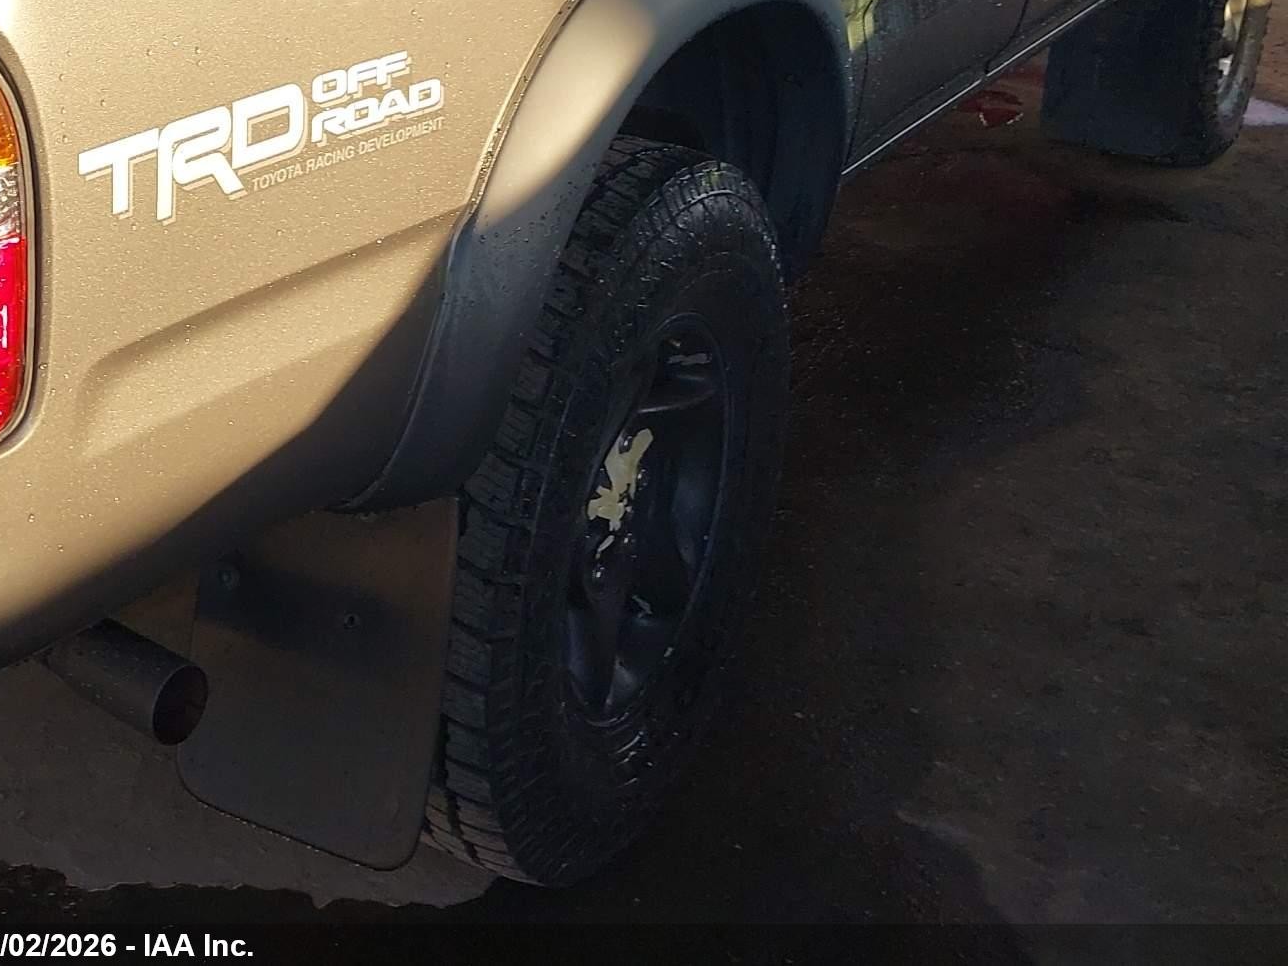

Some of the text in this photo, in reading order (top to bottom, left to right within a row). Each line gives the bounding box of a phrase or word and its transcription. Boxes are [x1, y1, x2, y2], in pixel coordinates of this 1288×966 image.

[311, 50, 411, 106] OFF
[311, 77, 444, 146] ROAD
[78, 82, 307, 225] TRD
[252, 116, 445, 191] TOYOTA RACING DEVELOPMENT
